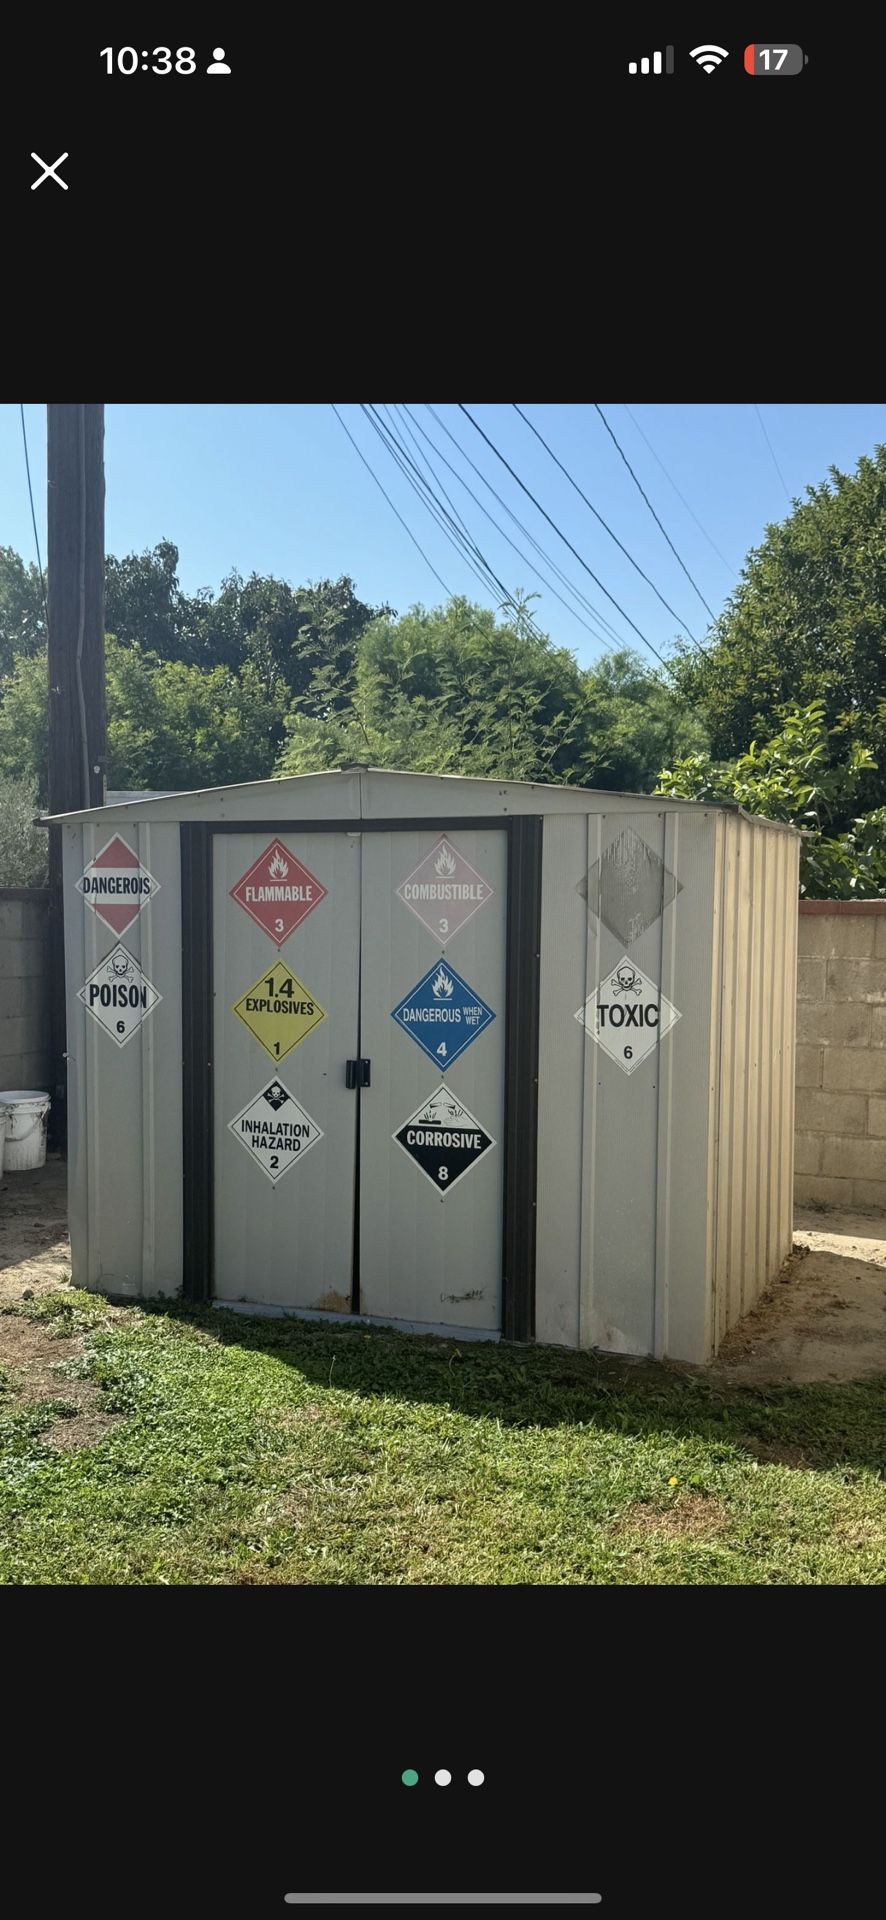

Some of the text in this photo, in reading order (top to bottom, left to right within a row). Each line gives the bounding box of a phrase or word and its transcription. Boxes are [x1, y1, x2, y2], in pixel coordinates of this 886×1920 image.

[245, 885, 313, 902] FLAMMABLE
[404, 884, 484, 901] COMBUSTIBLE
[274, 918, 284, 933] 3
[438, 918, 449, 933] 3
[264, 977, 295, 998] 1.4
[90, 984, 147, 1009] POISON
[245, 998, 315, 1016] EXPLOSIVES
[403, 1007, 462, 1023] DANGEROUS
[462, 1006, 483, 1016] WHEN
[465, 1016, 481, 1026] WET
[597, 1004, 660, 1028] TOXIC
[116, 1020, 126, 1034] 6
[273, 1041, 281, 1055] 1
[436, 1041, 448, 1057] 4
[623, 1045, 634, 1060] 6
[241, 1119, 310, 1138] INHALATION
[251, 1135, 301, 1152] HAZARD
[406, 1130, 482, 1149] CORROSIVE
[269, 1155, 279, 1169] 2
[438, 1166, 449, 1181] 8
